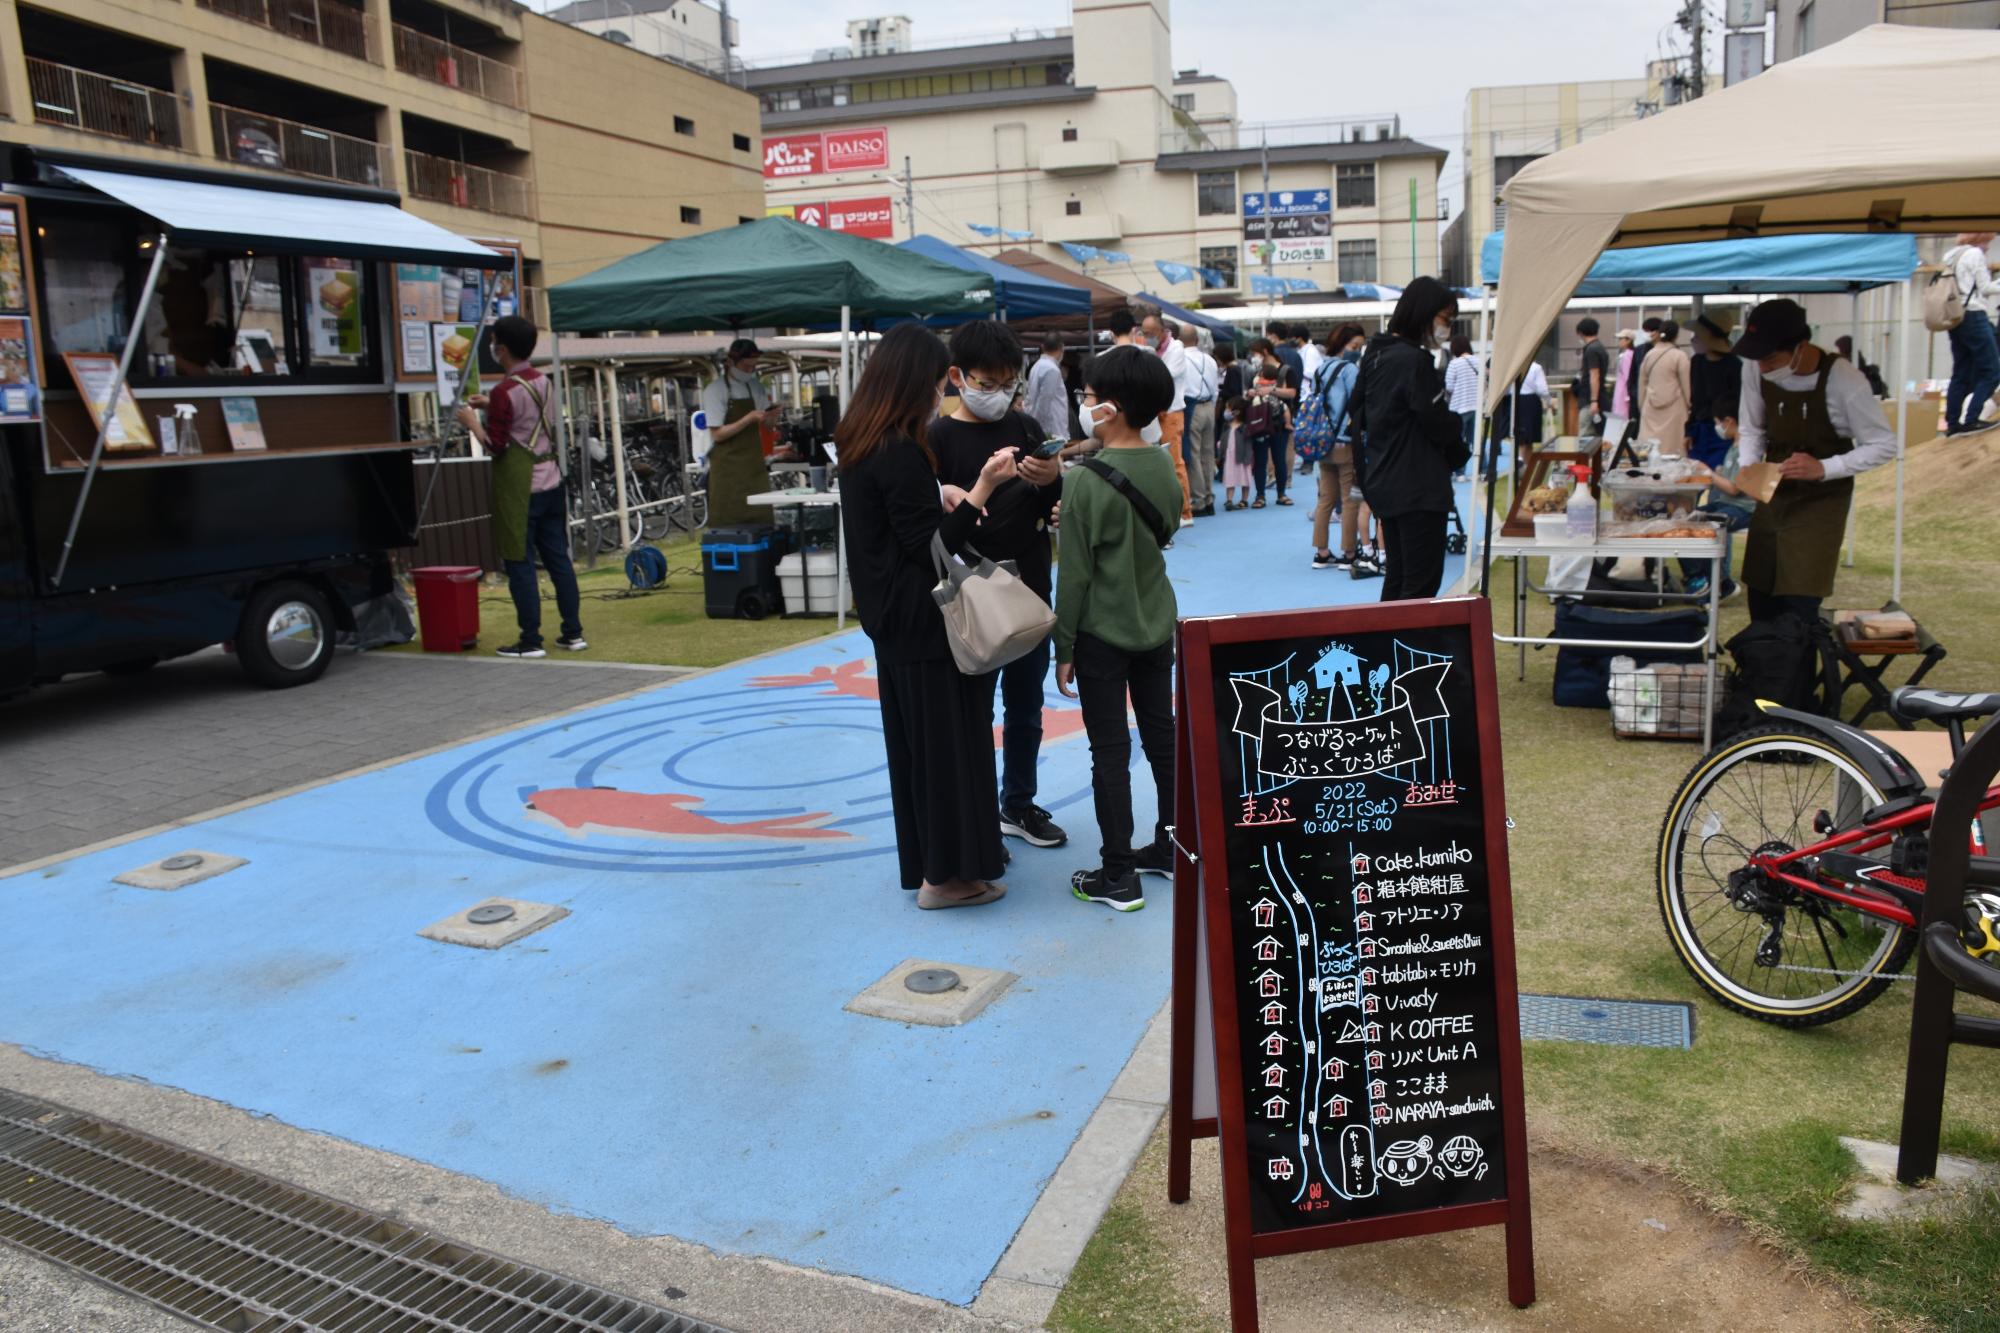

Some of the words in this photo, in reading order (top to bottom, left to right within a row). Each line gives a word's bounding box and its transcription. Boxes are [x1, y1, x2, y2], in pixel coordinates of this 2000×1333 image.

[764, 142, 815, 165] パレット
[829, 138, 883, 155] DAISO
[1277, 217, 1299, 230] cafe
[1280, 248, 1325, 261] ひのき塾
[1318, 640, 1354, 657] EVENT
[1277, 720, 1402, 751] つなげるマーケット
[1323, 782, 1367, 800] 2022
[1405, 779, 1457, 804] おみせ
[1242, 791, 1291, 824] まっぷ
[1315, 797, 1397, 819] 5/21(Sat)
[1356, 859, 1366, 874] 7
[1375, 840, 1473, 872] Cake.kumiko
[1358, 889, 1368, 903] 6
[1377, 873, 1469, 899] 箱本館紺屋
[1260, 906, 1272, 927] 7
[1360, 918, 1370, 931] 5
[1381, 903, 1463, 925] アトリエ・ノア
[1263, 943, 1273, 959] 6
[1319, 941, 1354, 958] ぶっく
[1363, 945, 1373, 957] 4
[1318, 955, 1358, 974] ひろば
[1264, 976, 1277, 996] 5
[1326, 981, 1354, 992] えほんの
[1363, 971, 1372, 985] 3
[1323, 990, 1357, 1004] よみきかせ
[1366, 1000, 1374, 1014] 2
[1267, 1008, 1279, 1024] 4
[1370, 1028, 1377, 1042] 1
[1390, 1022, 1405, 1041] K
[1409, 1015, 1474, 1039] COFFEE
[1269, 1038, 1280, 1054] 3
[1427, 1044, 1458, 1062] Unit
[1462, 1041, 1478, 1060] A
[1269, 1070, 1280, 1086] 2
[1374, 1084, 1382, 1099] 8
[1396, 1072, 1448, 1096] ここまま
[1272, 1102, 1280, 1117] 1
[1333, 1101, 1343, 1117] 8
[1374, 1105, 1387, 1119] 10
[1271, 1161, 1288, 1176] 10
[1298, 1200, 1330, 1211] いまココ
